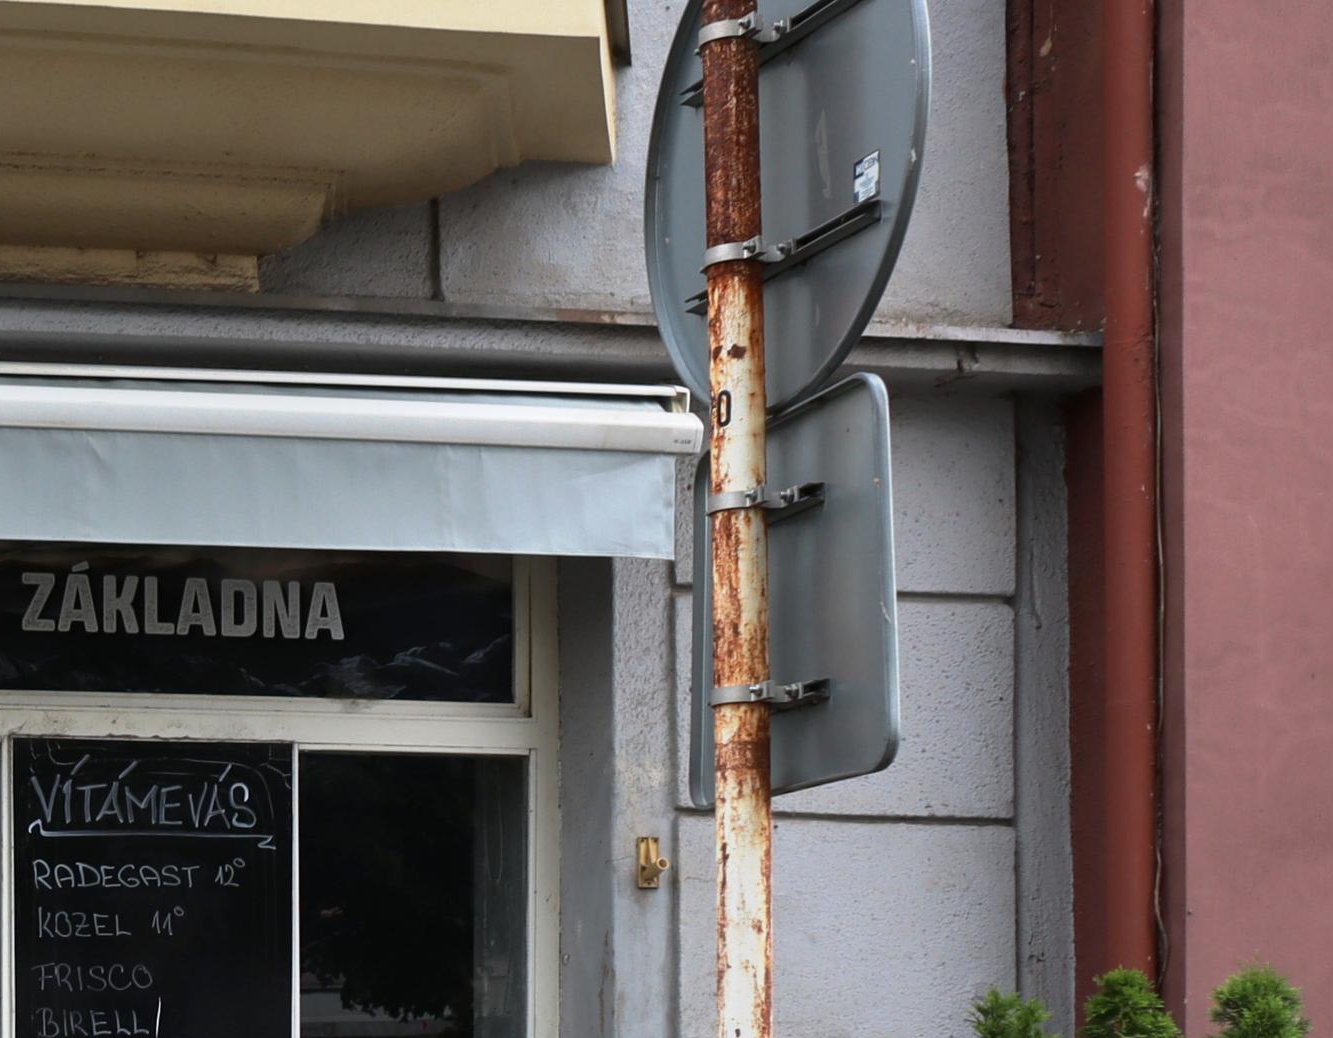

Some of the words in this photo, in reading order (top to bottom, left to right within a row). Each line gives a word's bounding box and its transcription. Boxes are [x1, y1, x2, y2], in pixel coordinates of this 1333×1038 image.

[21, 561, 346, 641] ZÁKLADNA
[32, 858, 201, 891] RADEGAST
[38, 906, 133, 939] KOZEL
[31, 962, 154, 993] FRISCO
